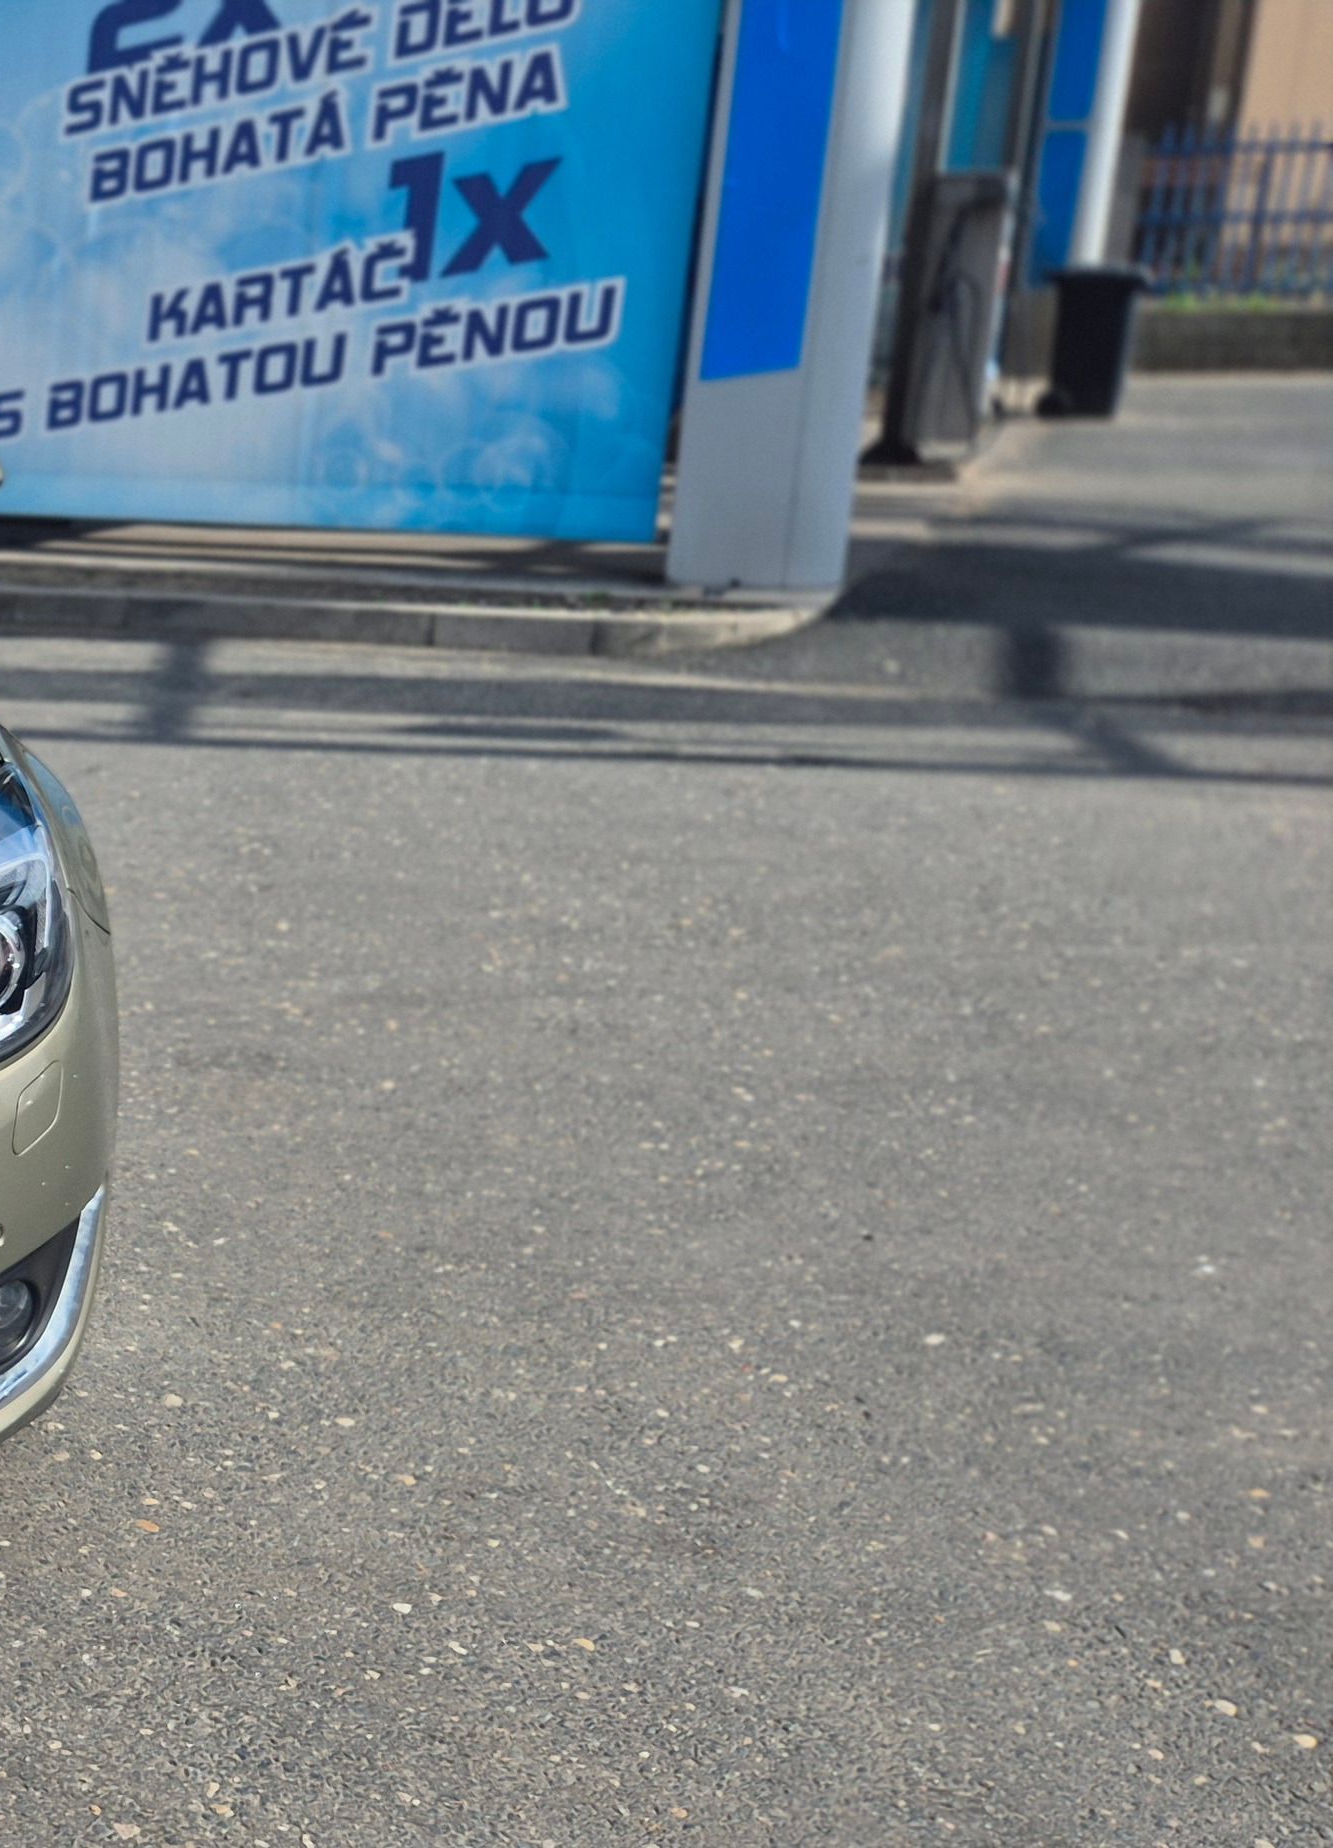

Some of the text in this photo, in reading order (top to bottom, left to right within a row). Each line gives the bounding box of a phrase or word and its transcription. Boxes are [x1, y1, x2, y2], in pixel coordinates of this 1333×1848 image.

[64, 9, 371, 136] SNĚHOVÉ
[89, 51, 560, 203] BOHATÁ PĚNA
[389, 151, 564, 284] 1x
[147, 240, 407, 343] KARTÁČ
[45, 333, 348, 432] BOHATOU
[371, 286, 619, 377] PĚNOU
